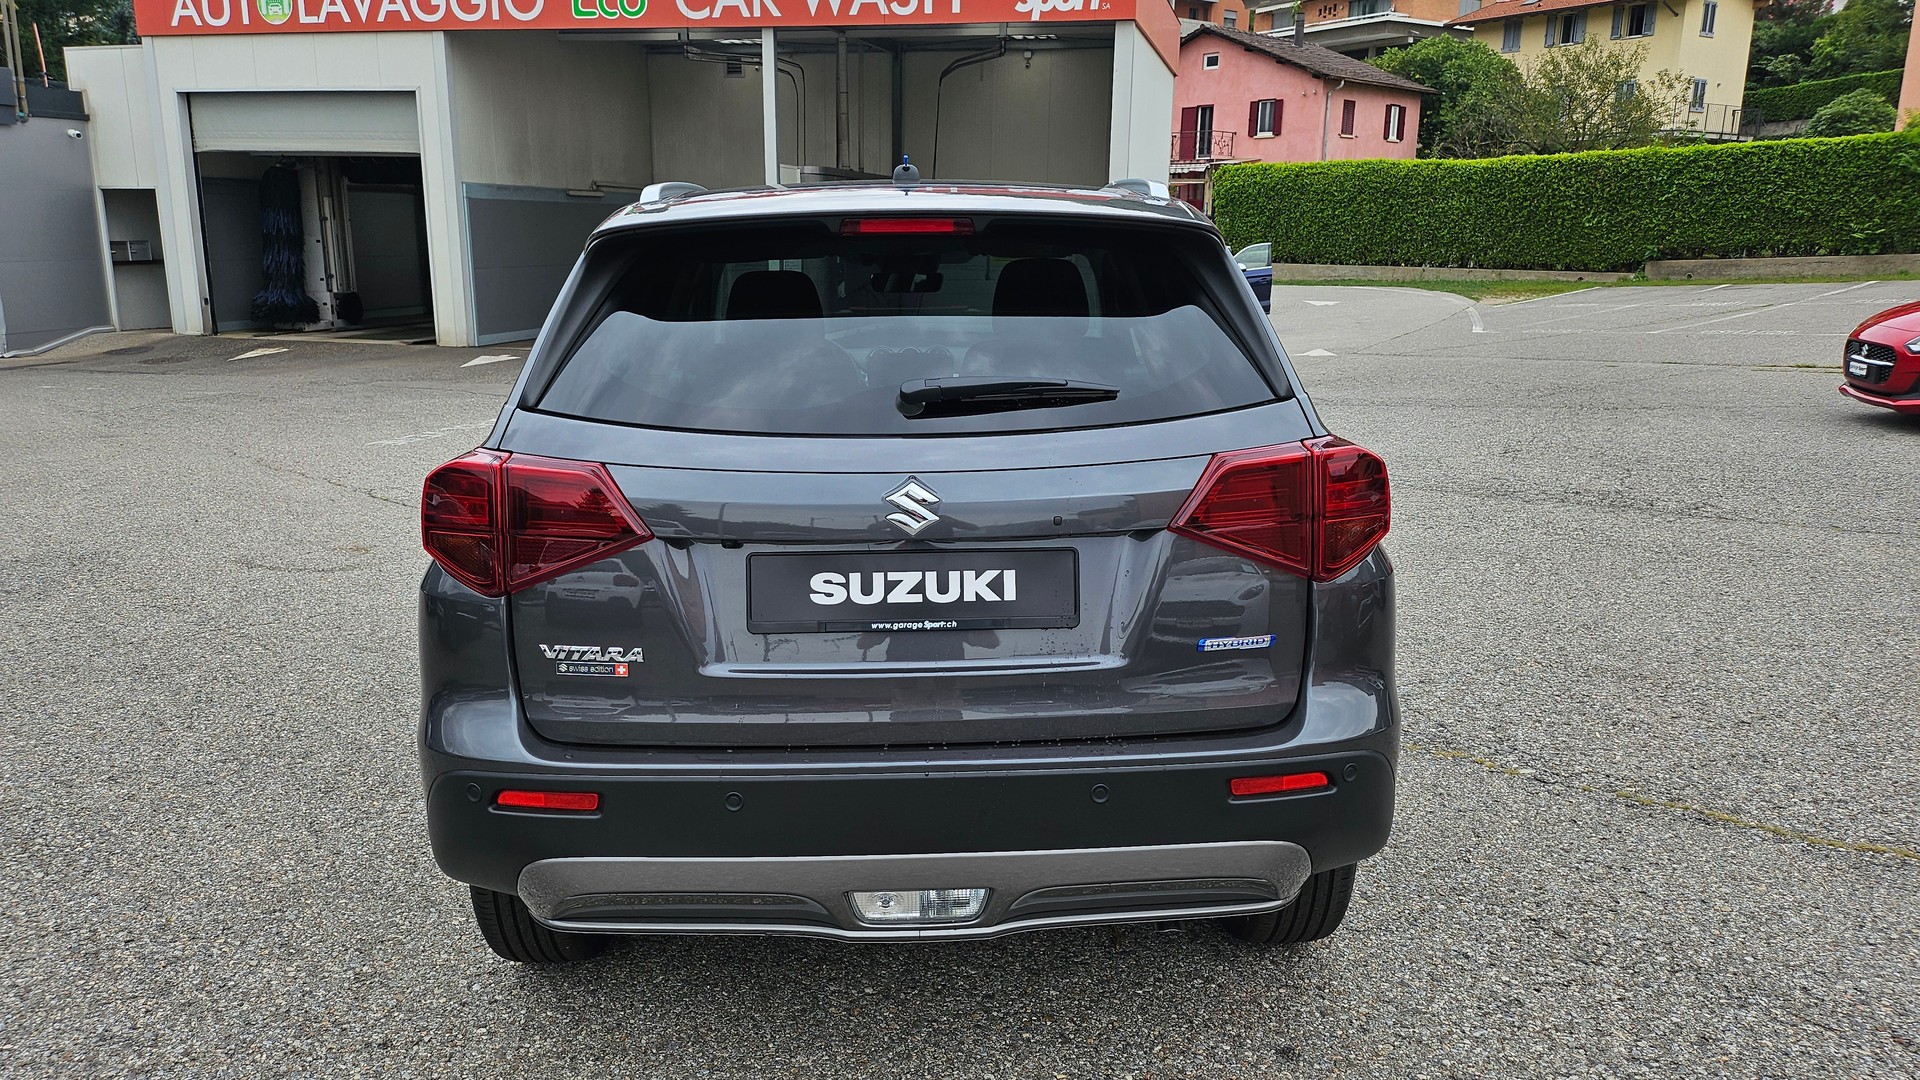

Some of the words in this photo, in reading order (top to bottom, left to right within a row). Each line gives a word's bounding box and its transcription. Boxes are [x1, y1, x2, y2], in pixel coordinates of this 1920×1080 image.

[809, 569, 1017, 606] SUZUKI
[1210, 637, 1266, 649] HYBRID
[538, 644, 645, 663] VITARA
[568, 664, 589, 673] swiss
[590, 663, 614, 673] edition
